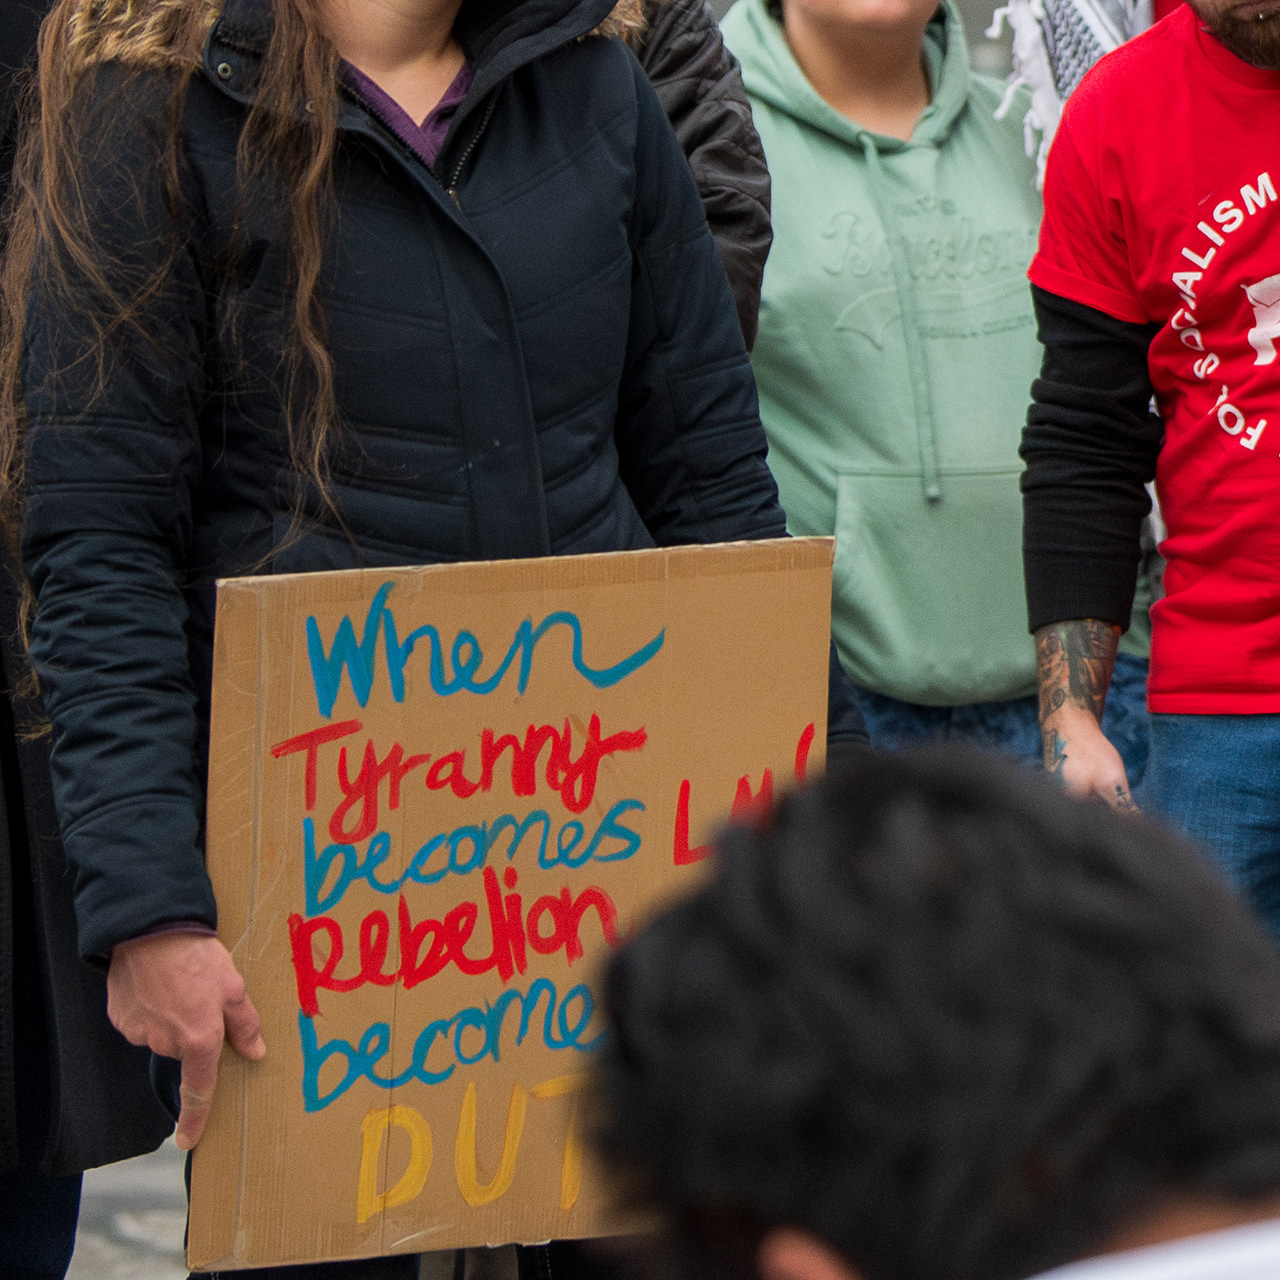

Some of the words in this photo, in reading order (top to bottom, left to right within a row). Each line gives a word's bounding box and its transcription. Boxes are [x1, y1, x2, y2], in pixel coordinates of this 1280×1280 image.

[305, 581, 665, 719] When
[270, 712, 648, 846] Tyranny
[302, 799, 646, 918] becomes
[298, 977, 608, 1113] become
[356, 1072, 598, 1224] DUT
